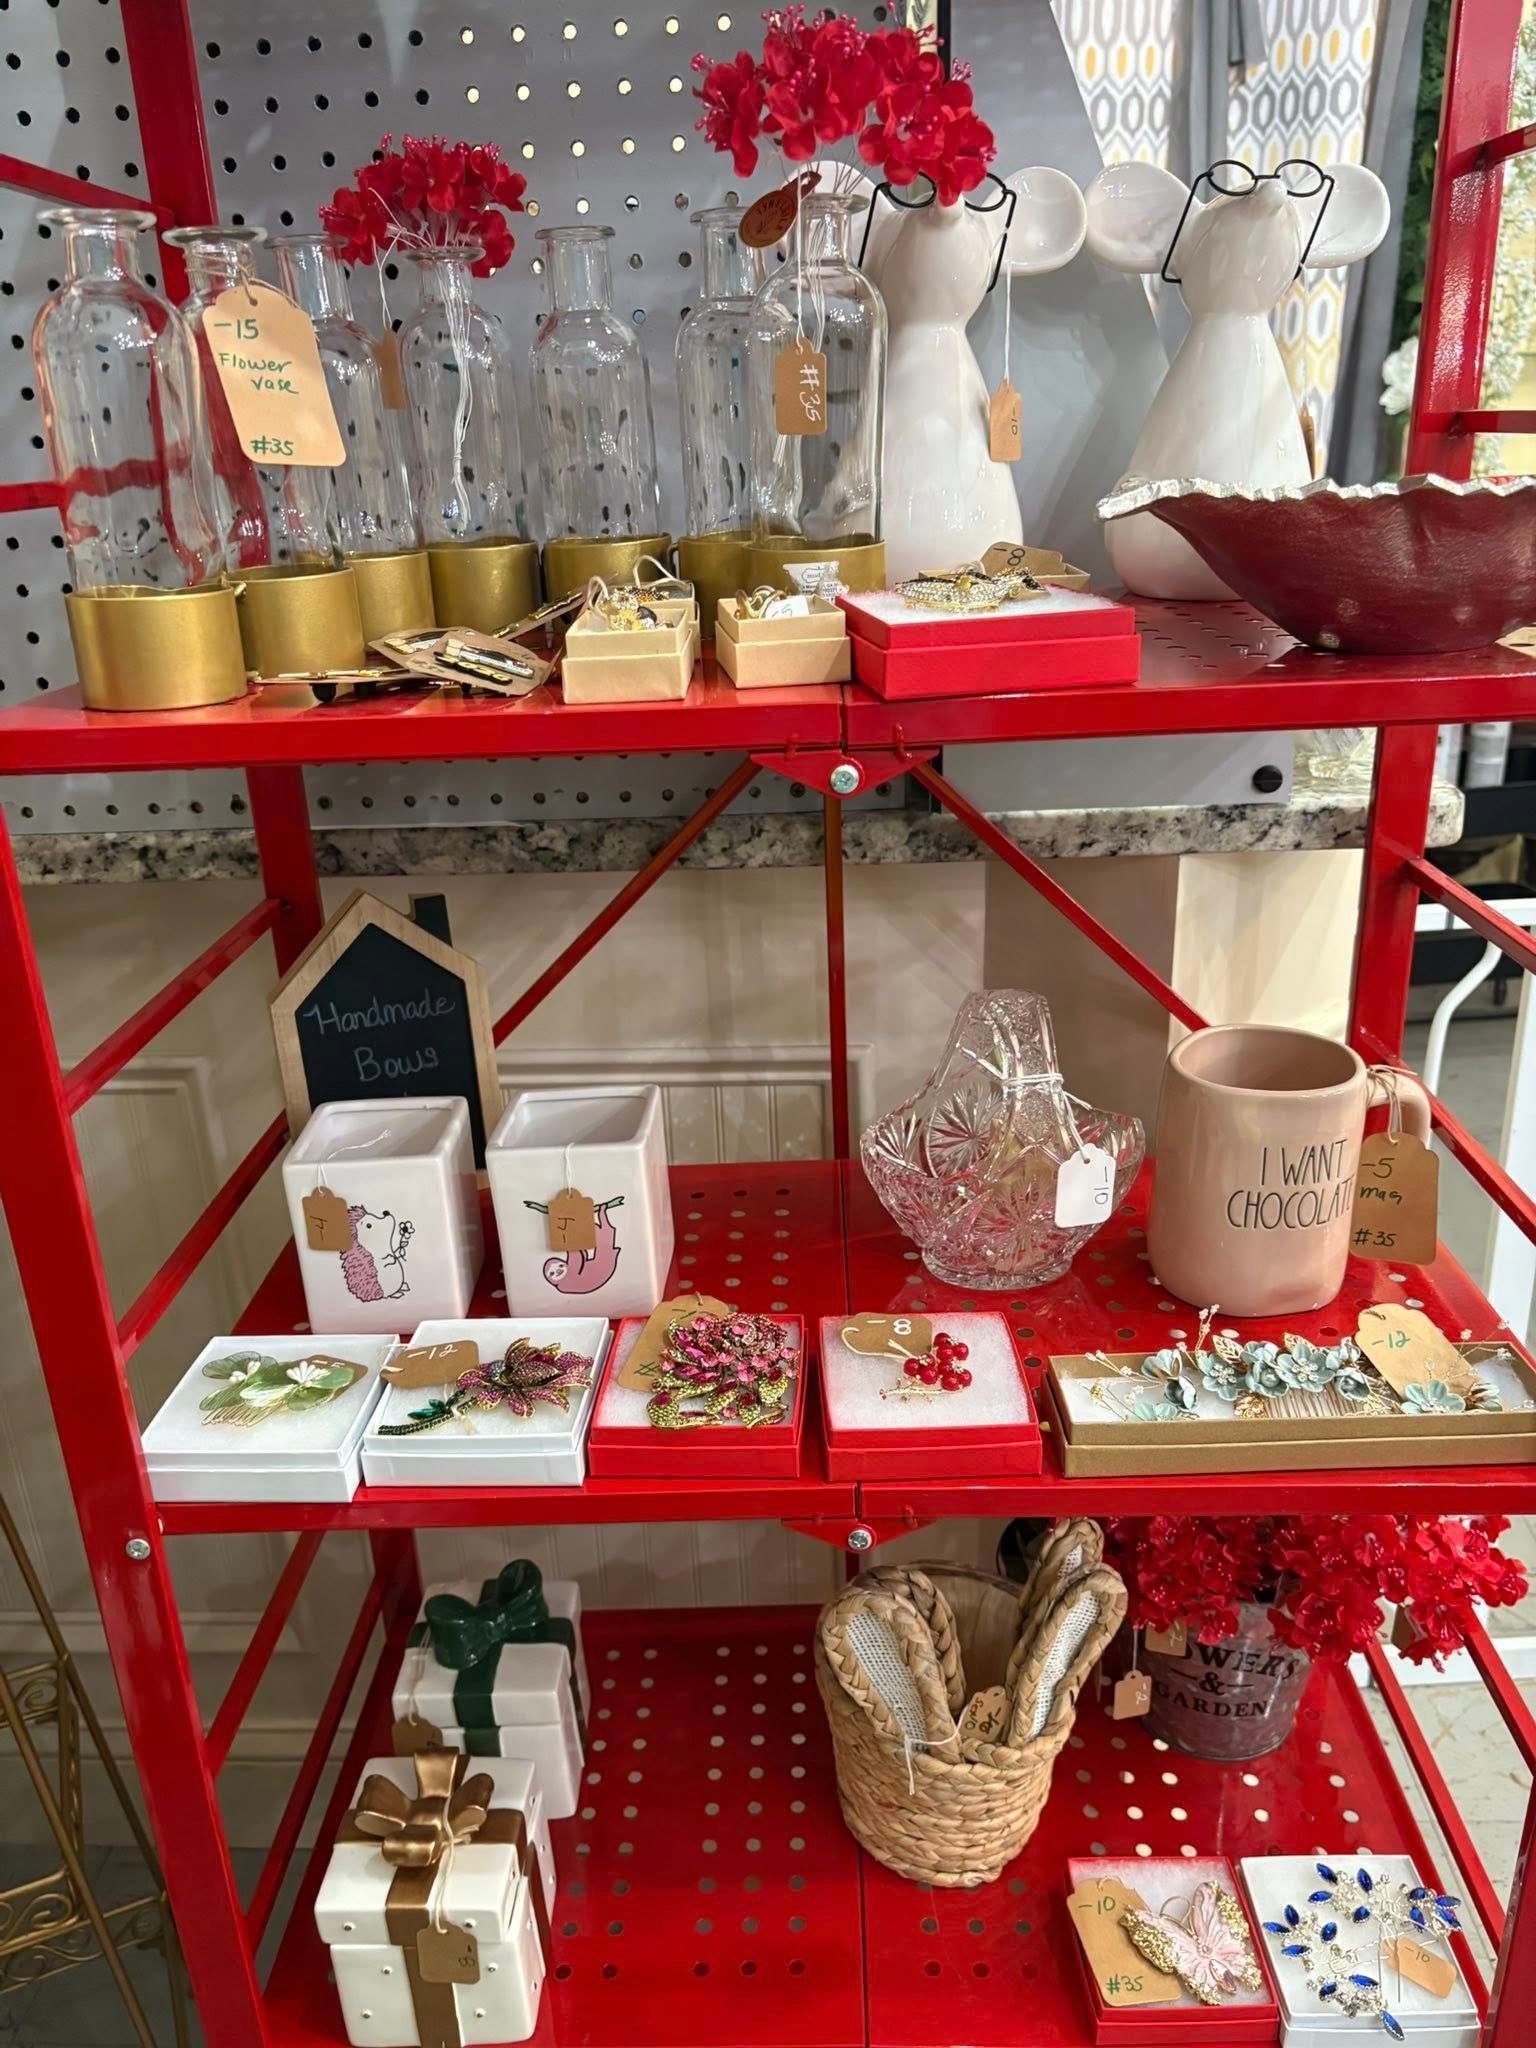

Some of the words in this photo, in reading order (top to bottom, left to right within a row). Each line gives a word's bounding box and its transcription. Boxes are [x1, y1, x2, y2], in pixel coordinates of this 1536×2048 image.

[214, 319, 259, 340] -15
[219, 353, 292, 373] Flower
[799, 364, 822, 422] #35
[251, 436, 294, 456] #35
[993, 548, 1026, 566] -8
[303, 987, 457, 1035] Handmade
[354, 1046, 439, 1082] Bows
[1261, 1147, 1268, 1186] I
[1281, 1138, 1348, 1186] WANT
[1361, 1157, 1396, 1179] -5
[1093, 1166, 1110, 1205] -10
[866, 1318, 912, 1336] -8
[1371, 1330, 1411, 1349] -12
[407, 1344, 459, 1360] -12
[1199, 1671, 1225, 1696] &
[1155, 1680, 1269, 1718] GARDEN
[1078, 1895, 1117, 1916] -10
[1404, 1946, 1431, 1963] -10
[1106, 1974, 1144, 1996] #35
